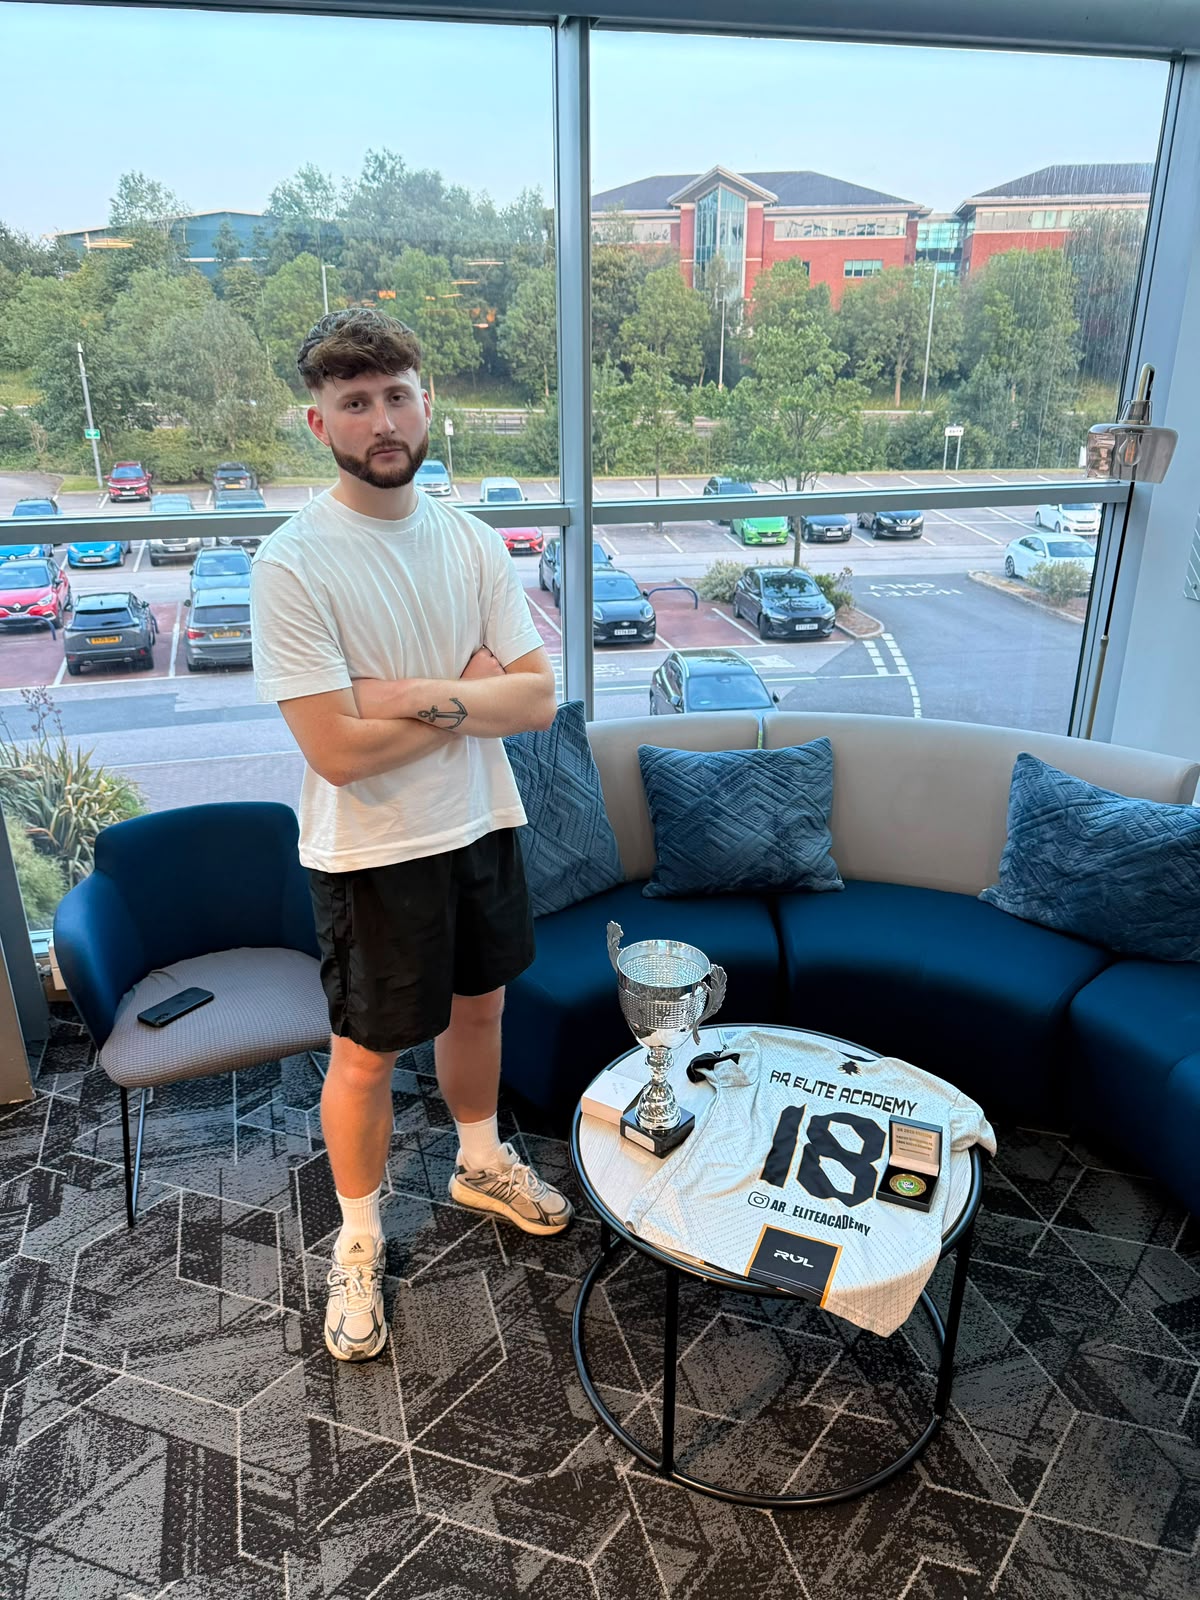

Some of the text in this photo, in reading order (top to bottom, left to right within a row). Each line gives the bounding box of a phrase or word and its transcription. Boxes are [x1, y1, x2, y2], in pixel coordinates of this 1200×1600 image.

[769, 1070, 917, 1116] AR ELITE ACADEMY
[759, 1103, 886, 1207] 18
[770, 1199, 871, 1236] AR_ELITEACADEMY
